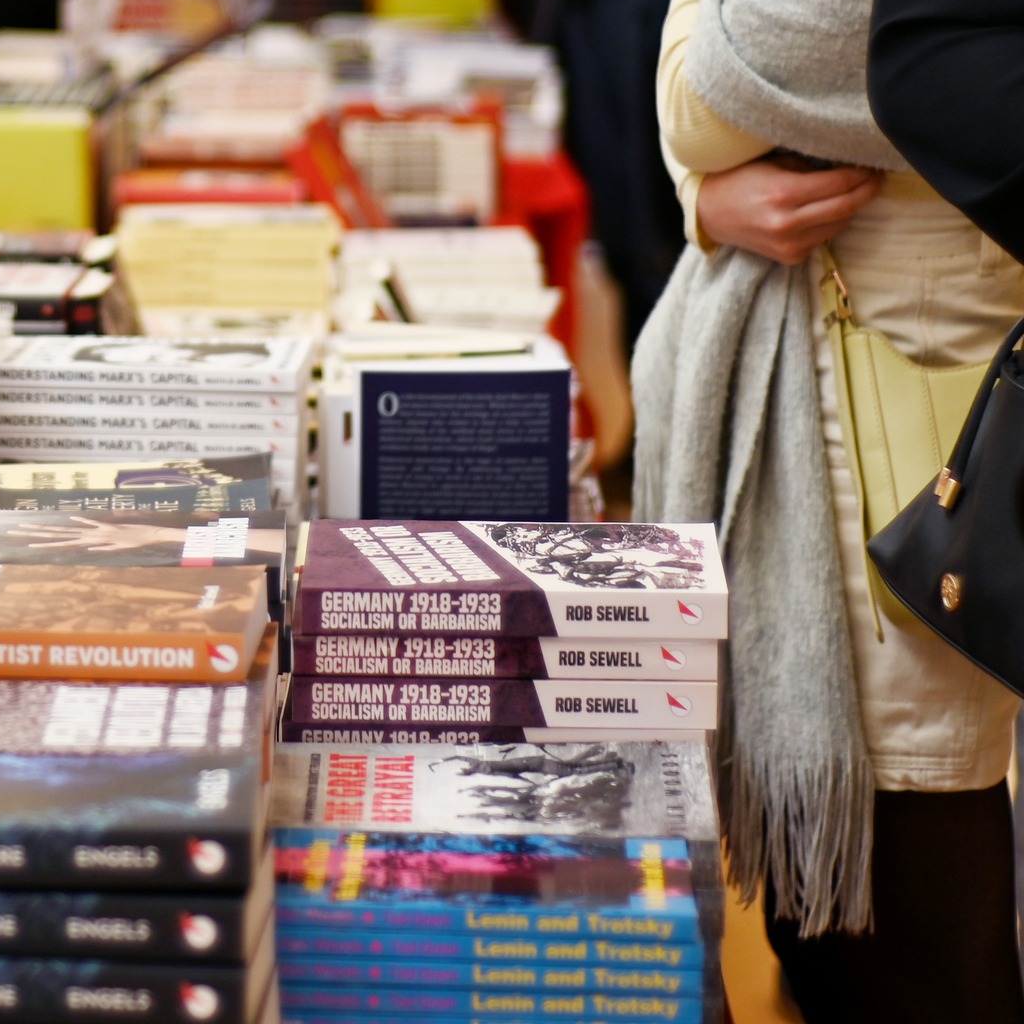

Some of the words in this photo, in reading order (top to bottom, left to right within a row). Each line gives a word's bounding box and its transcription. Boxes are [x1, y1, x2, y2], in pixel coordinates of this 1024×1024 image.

[99, 371, 145, 384] MARX'S
[150, 372, 199, 385] CAPITAL
[99, 394, 144, 407] MARX'S
[150, 396, 199, 408] CAPITAL
[101, 417, 147, 430] MARX'S
[152, 418, 202, 430] CAPITAL
[98, 440, 144, 452] MARX'S
[150, 441, 198, 452] CAPITAL
[321, 592, 404, 613] GERMANY
[321, 612, 394, 630] SOCIALISM
[398, 614, 416, 630] OR
[421, 614, 502, 630] BARBARISM
[566, 606, 592, 622] ROB
[596, 606, 650, 622] SEWELL
[50, 644, 194, 668] REVOLUTION
[316, 636, 398, 658] GERMANY
[316, 658, 388, 674] SOCIALISM
[392, 658, 410, 674] OR
[416, 659, 495, 676] BARBARISM
[558, 650, 586, 666] ROB
[590, 651, 642, 667] SEWELL
[312, 682, 394, 704] GERMANY
[312, 704, 384, 720] SOCIALISM
[388, 704, 406, 720] OR
[411, 706, 490, 722] BARBARISM
[555, 697, 582, 712] ROB
[586, 698, 638, 714] SEWELL
[326, 754, 368, 797] GREAT
[372, 756, 414, 822] BETRAYAL
[74, 845, 160, 868] ENGELS
[66, 916, 152, 941] ENGELS
[466, 910, 529, 930] Lenin
[537, 914, 579, 932] and
[587, 912, 674, 938] Trotsky
[476, 938, 538, 958] Lenin
[546, 942, 587, 960] and
[596, 940, 682, 966] Trotsky
[474, 965, 536, 984] Lenin
[544, 970, 586, 987] and
[594, 967, 680, 992] Trotsky
[66, 986, 152, 1011] ENGELS
[472, 992, 534, 1011] Lenin
[542, 996, 584, 1013] and
[592, 994, 679, 1020] Trotsky
